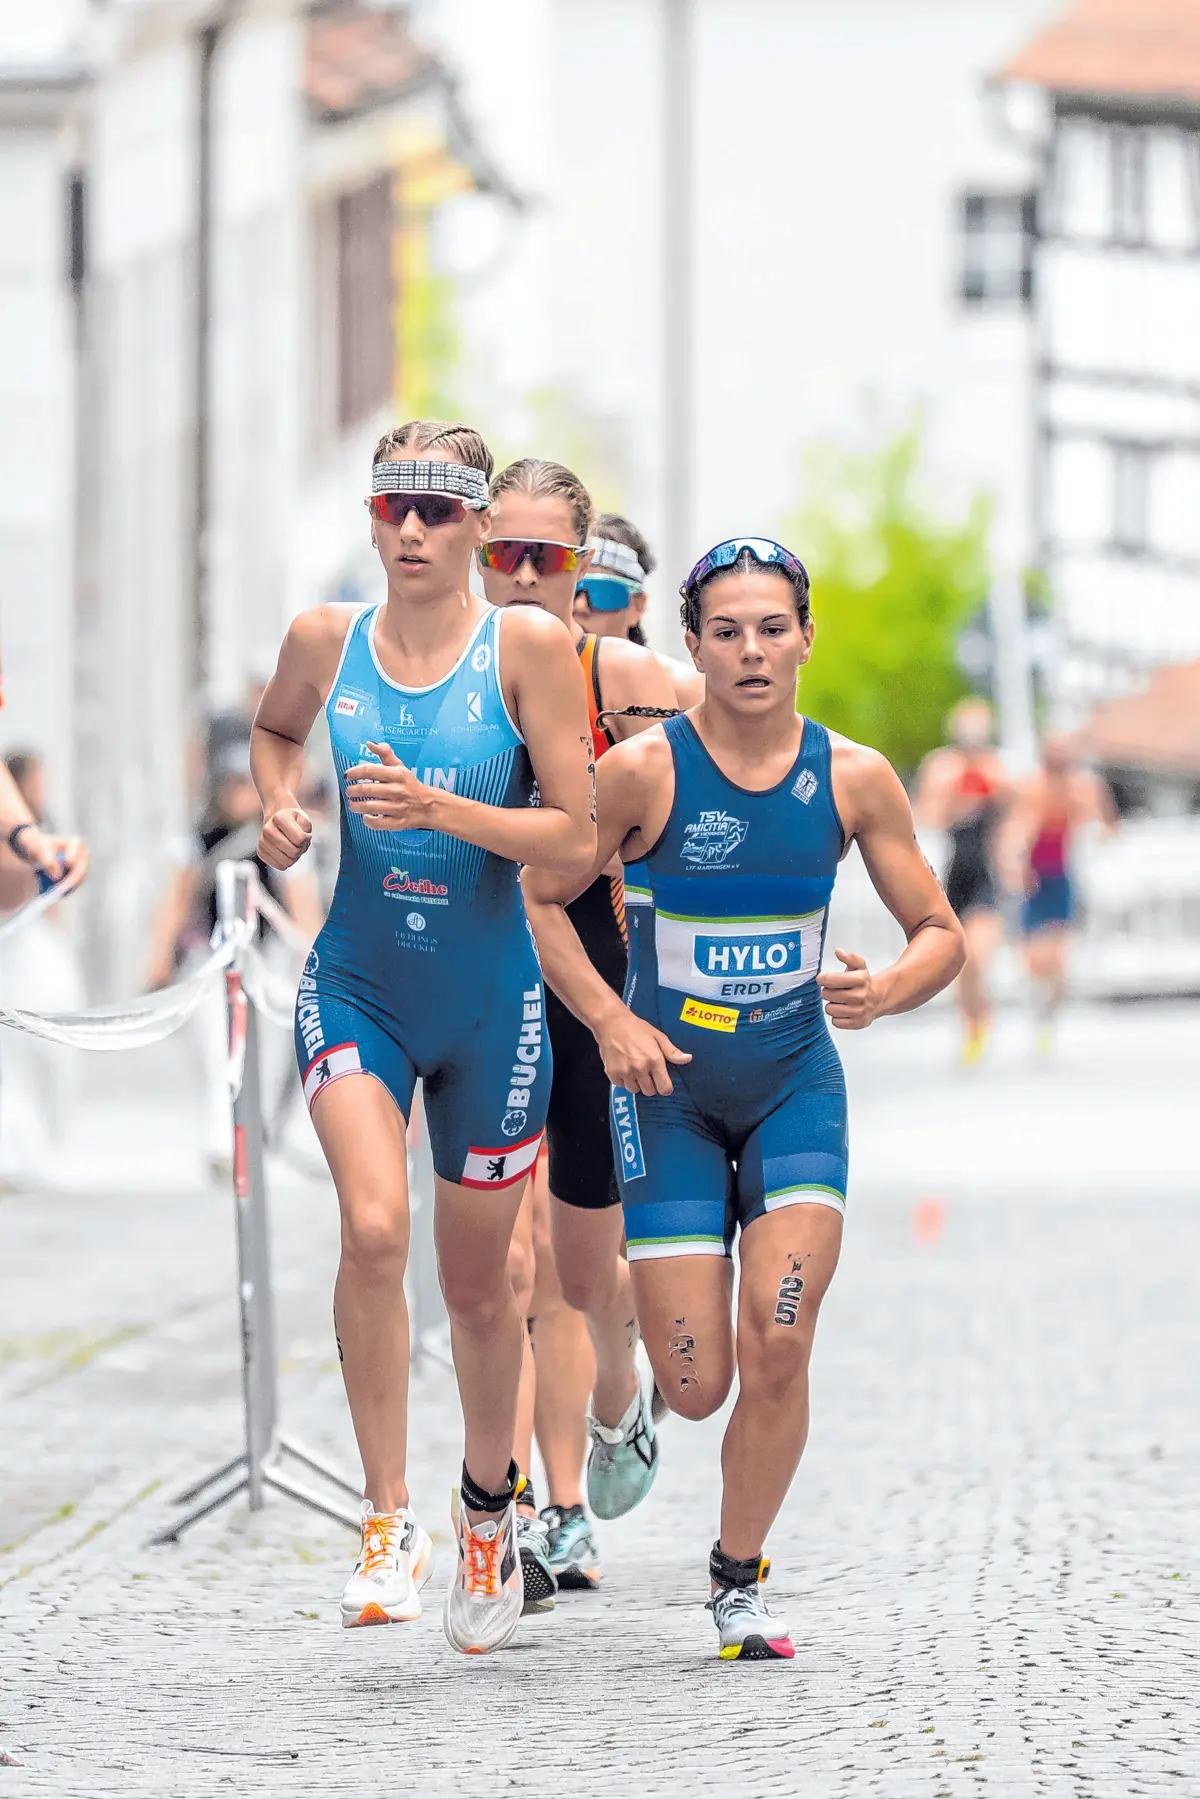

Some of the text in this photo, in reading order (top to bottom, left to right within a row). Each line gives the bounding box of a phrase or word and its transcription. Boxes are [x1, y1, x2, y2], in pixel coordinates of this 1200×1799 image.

[337, 701, 355, 711] BERLIN
[374, 722, 438, 736] KAISERGARTEN
[699, 811, 727, 823] TSV
[684, 822, 728, 833] AMICITIA
[383, 867, 448, 895] Weihe
[721, 982, 774, 996] ERDT
[699, 1011, 732, 1025] LOTTO
[507, 983, 541, 1107] BÜCHEL
[774, 1275, 805, 1327] 25
